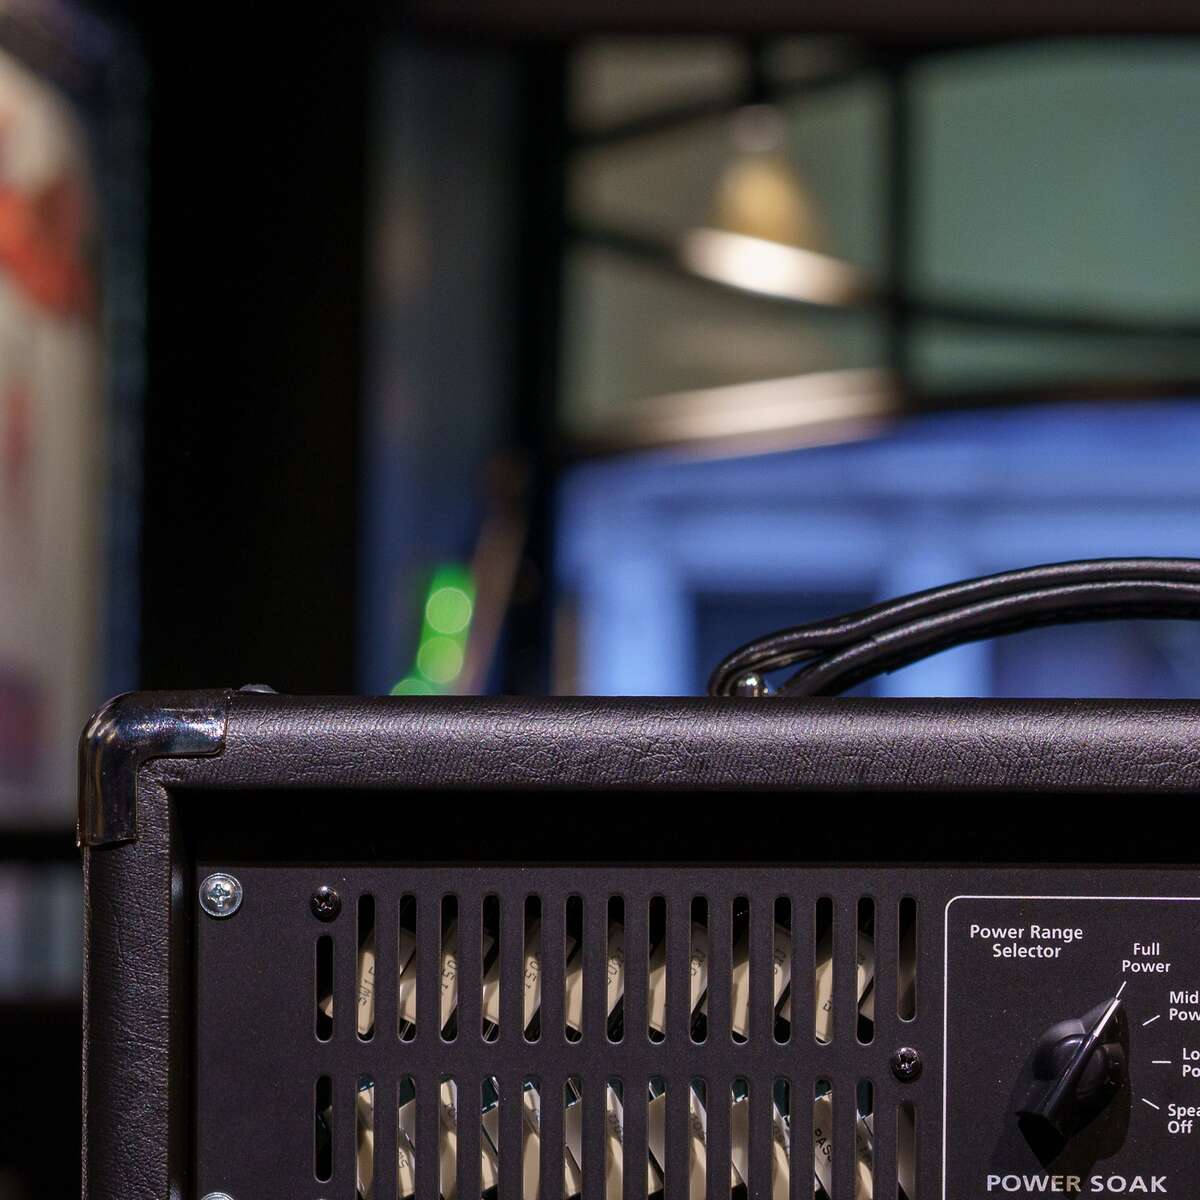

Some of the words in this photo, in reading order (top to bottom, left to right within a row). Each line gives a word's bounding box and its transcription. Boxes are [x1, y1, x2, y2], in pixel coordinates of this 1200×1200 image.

[970, 924, 1024, 938] Power
[1030, 924, 1084, 943] Range
[989, 943, 1062, 959] Selector
[1133, 942, 1159, 955] Full
[1122, 959, 1170, 972] Power
[1169, 990, 1198, 1003] Mid
[1167, 1119, 1192, 1133] Off
[986, 1174, 1081, 1191] POWER
[1090, 1175, 1167, 1192] SOAK
